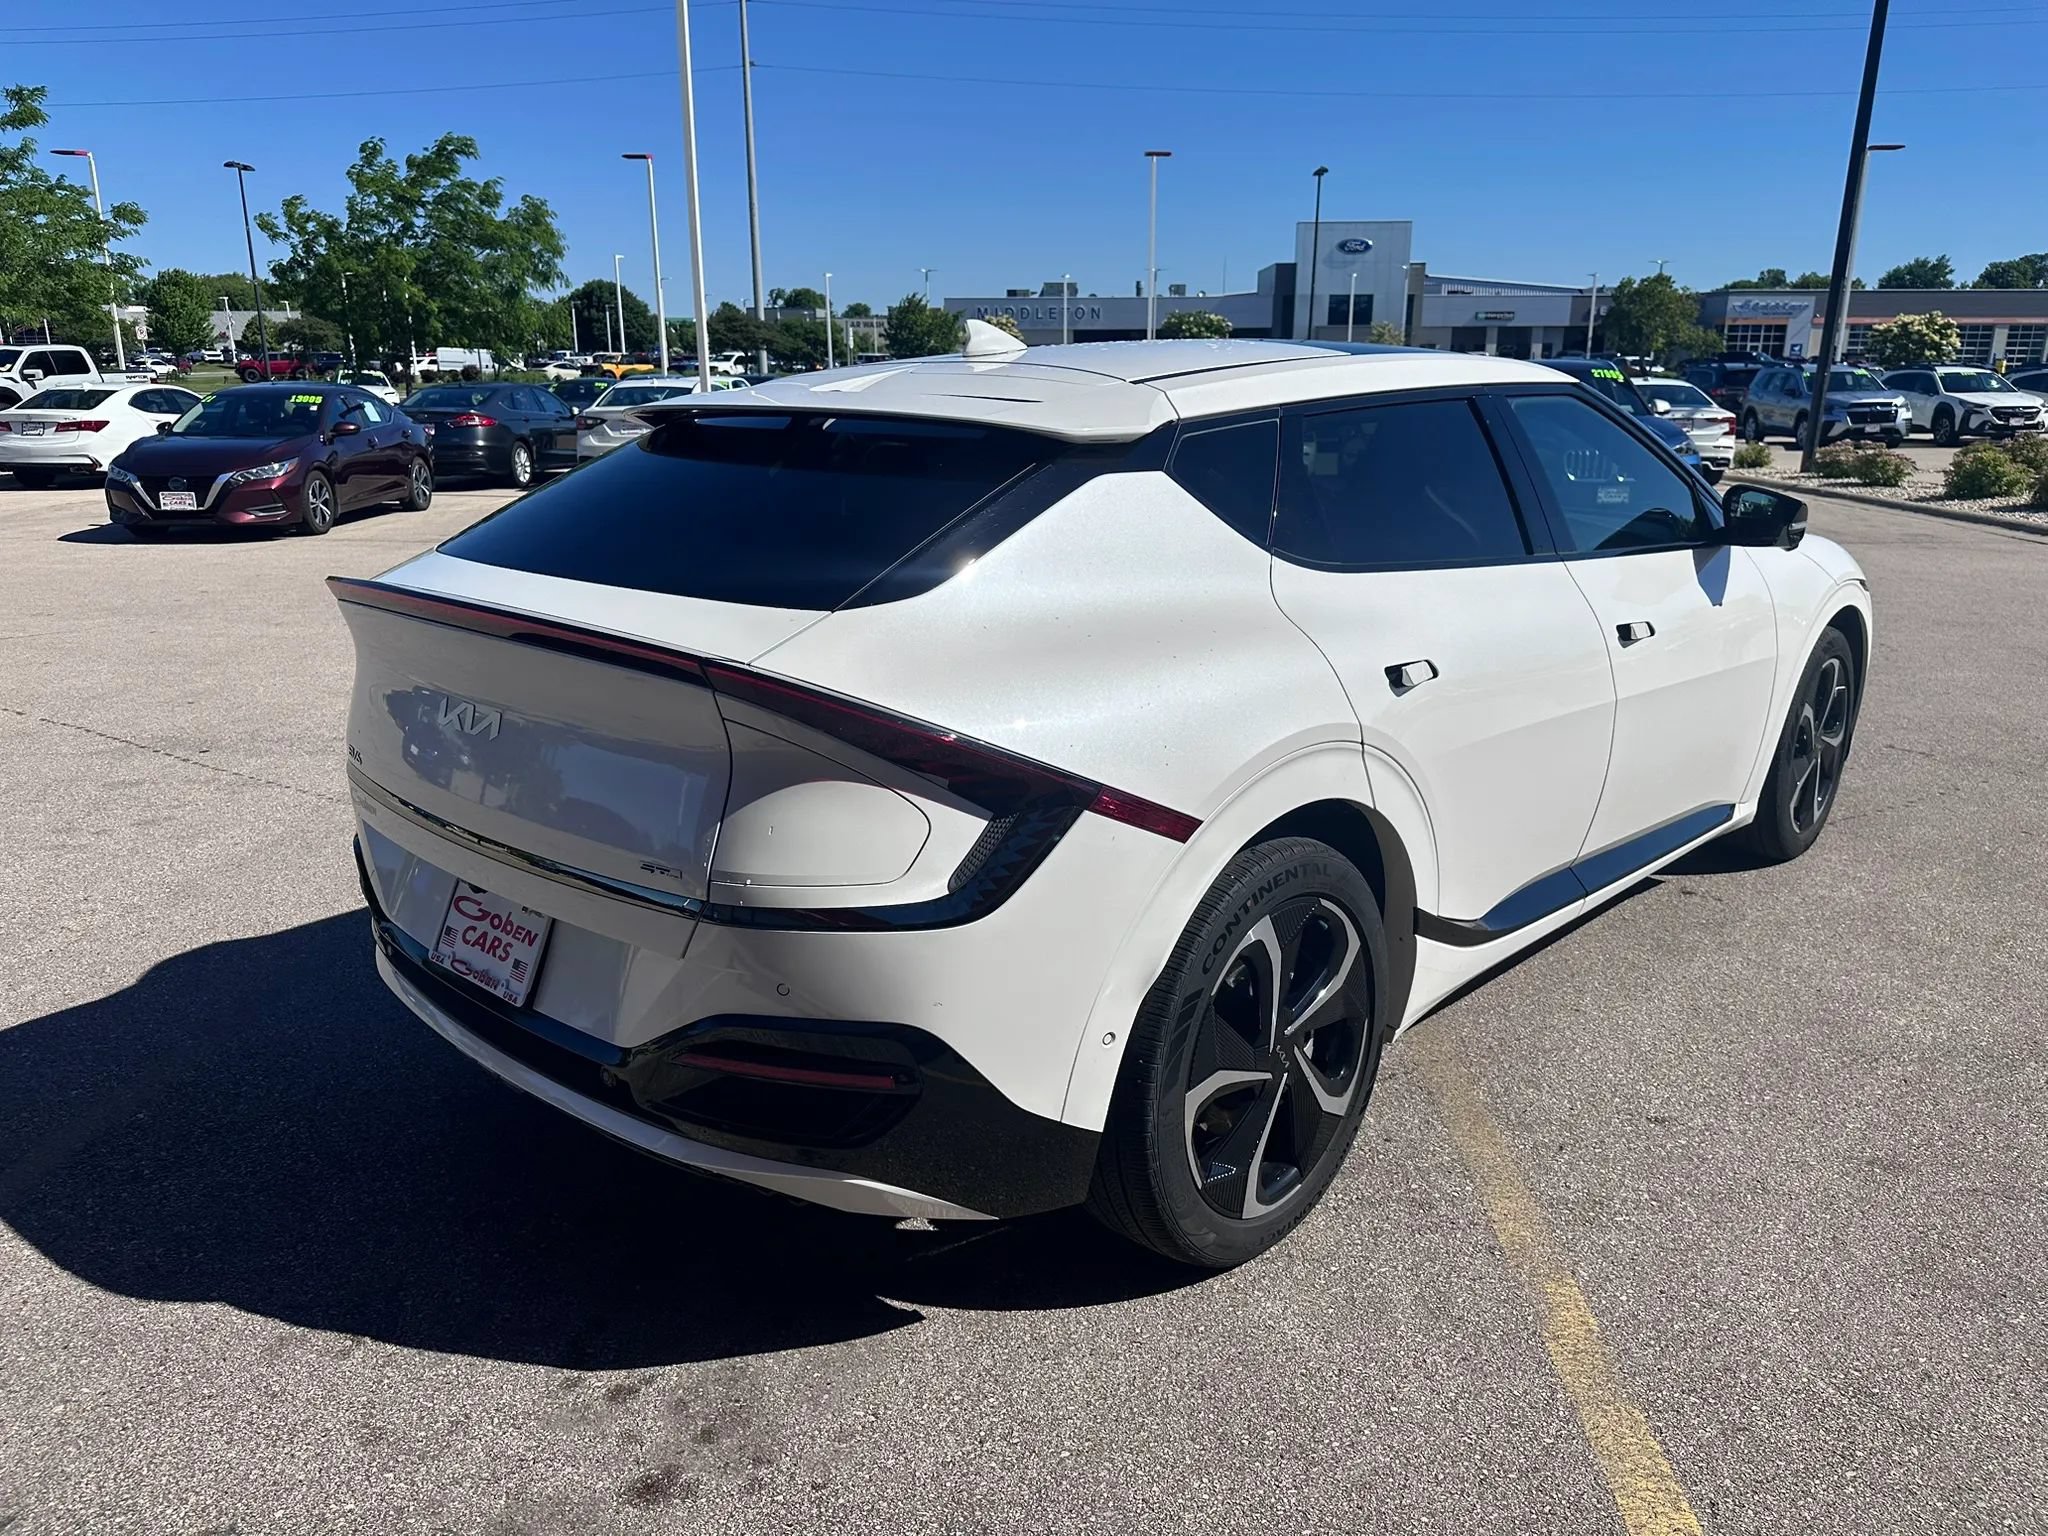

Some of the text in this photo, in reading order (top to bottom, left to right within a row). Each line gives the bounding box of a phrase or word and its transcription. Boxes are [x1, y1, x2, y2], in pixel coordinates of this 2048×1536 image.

[439, 695, 502, 741] KIA
[1202, 863, 1332, 976] CONTINENTAL
[430, 953, 445, 965] USA
[461, 925, 514, 962] CARS
[502, 990, 519, 1005] USA
